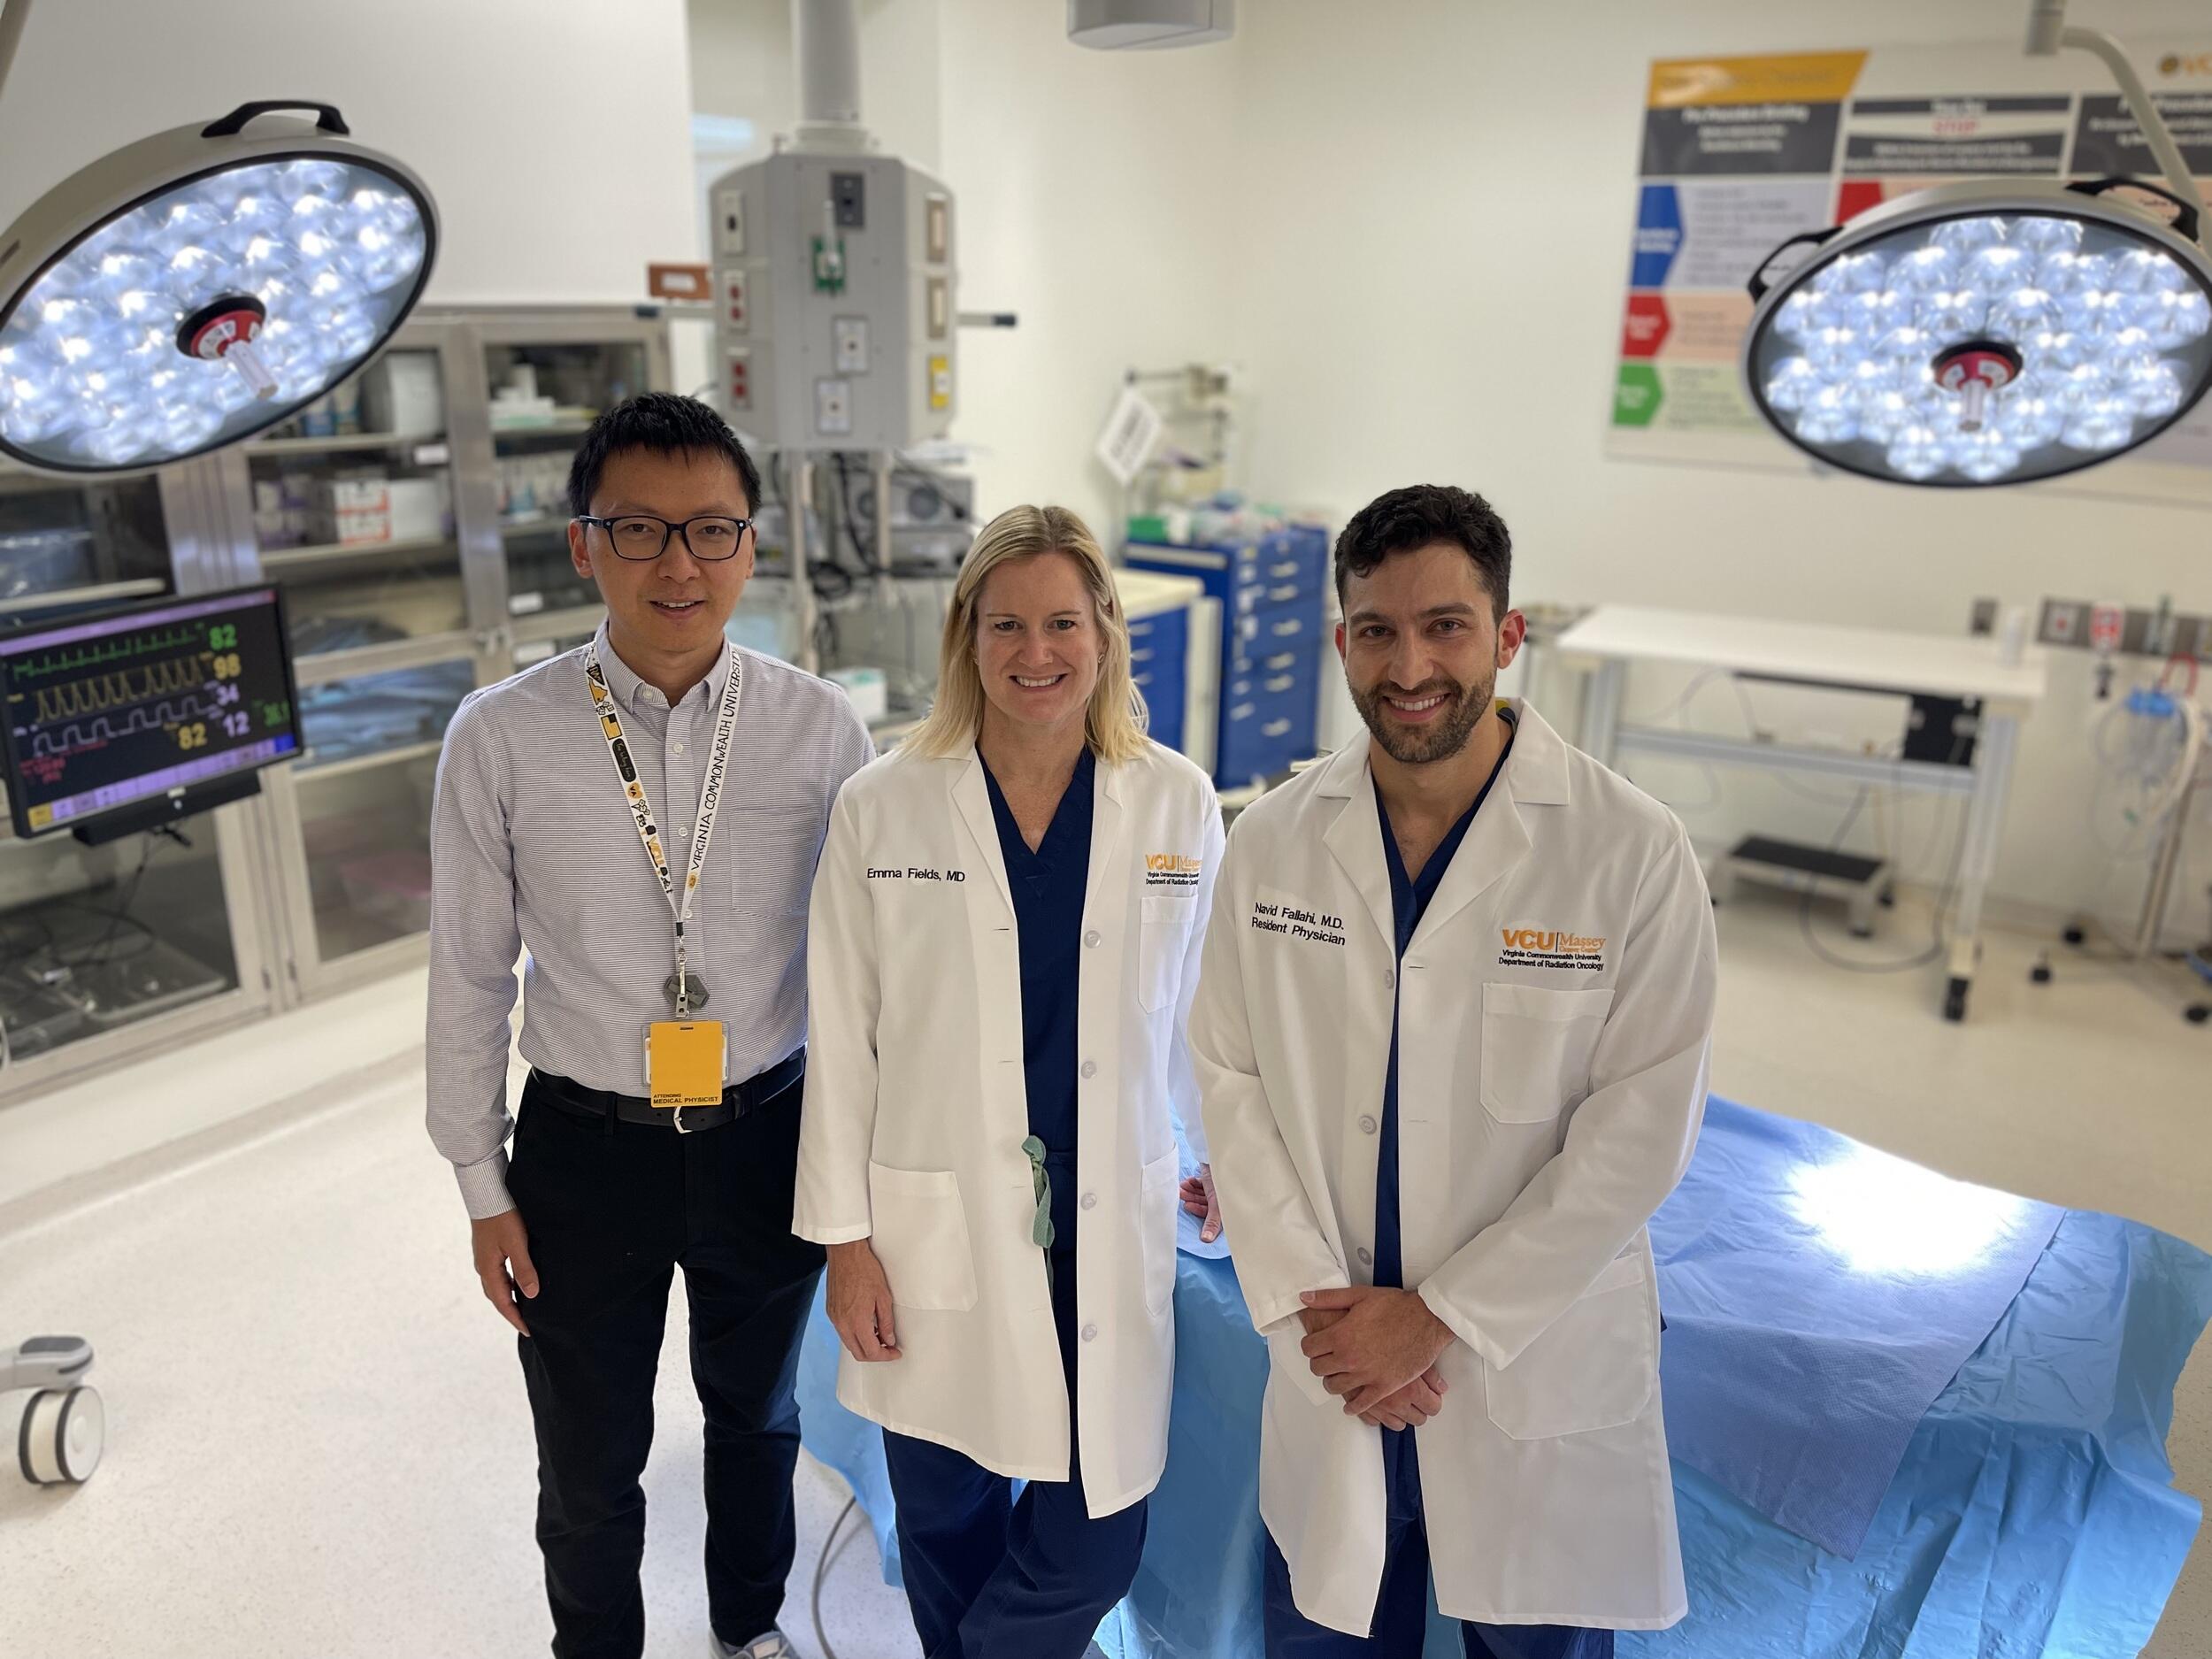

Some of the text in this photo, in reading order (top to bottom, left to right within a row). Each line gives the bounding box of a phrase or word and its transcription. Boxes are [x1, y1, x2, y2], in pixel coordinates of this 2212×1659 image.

[209, 624, 236, 649] 82
[179, 722, 207, 750] 82
[222, 711, 250, 738] 12
[690, 650, 741, 870] VIRGINIA COMMONWEALTH UNIVERSIT
[867, 868, 965, 882] Emma Fields, MD
[1145, 854, 1177, 871] VCU
[1255, 902, 1345, 930] Navid Fallahi, M.D.
[1251, 917, 1345, 945] Resident Physician
[1502, 929, 1607, 951] VCU Massey
[1498, 957, 1536, 966] Department
[1576, 962, 1604, 972] Oncology
[1502, 949, 1525, 958] Virginia
[1526, 951, 1573, 960] Commonwealth
